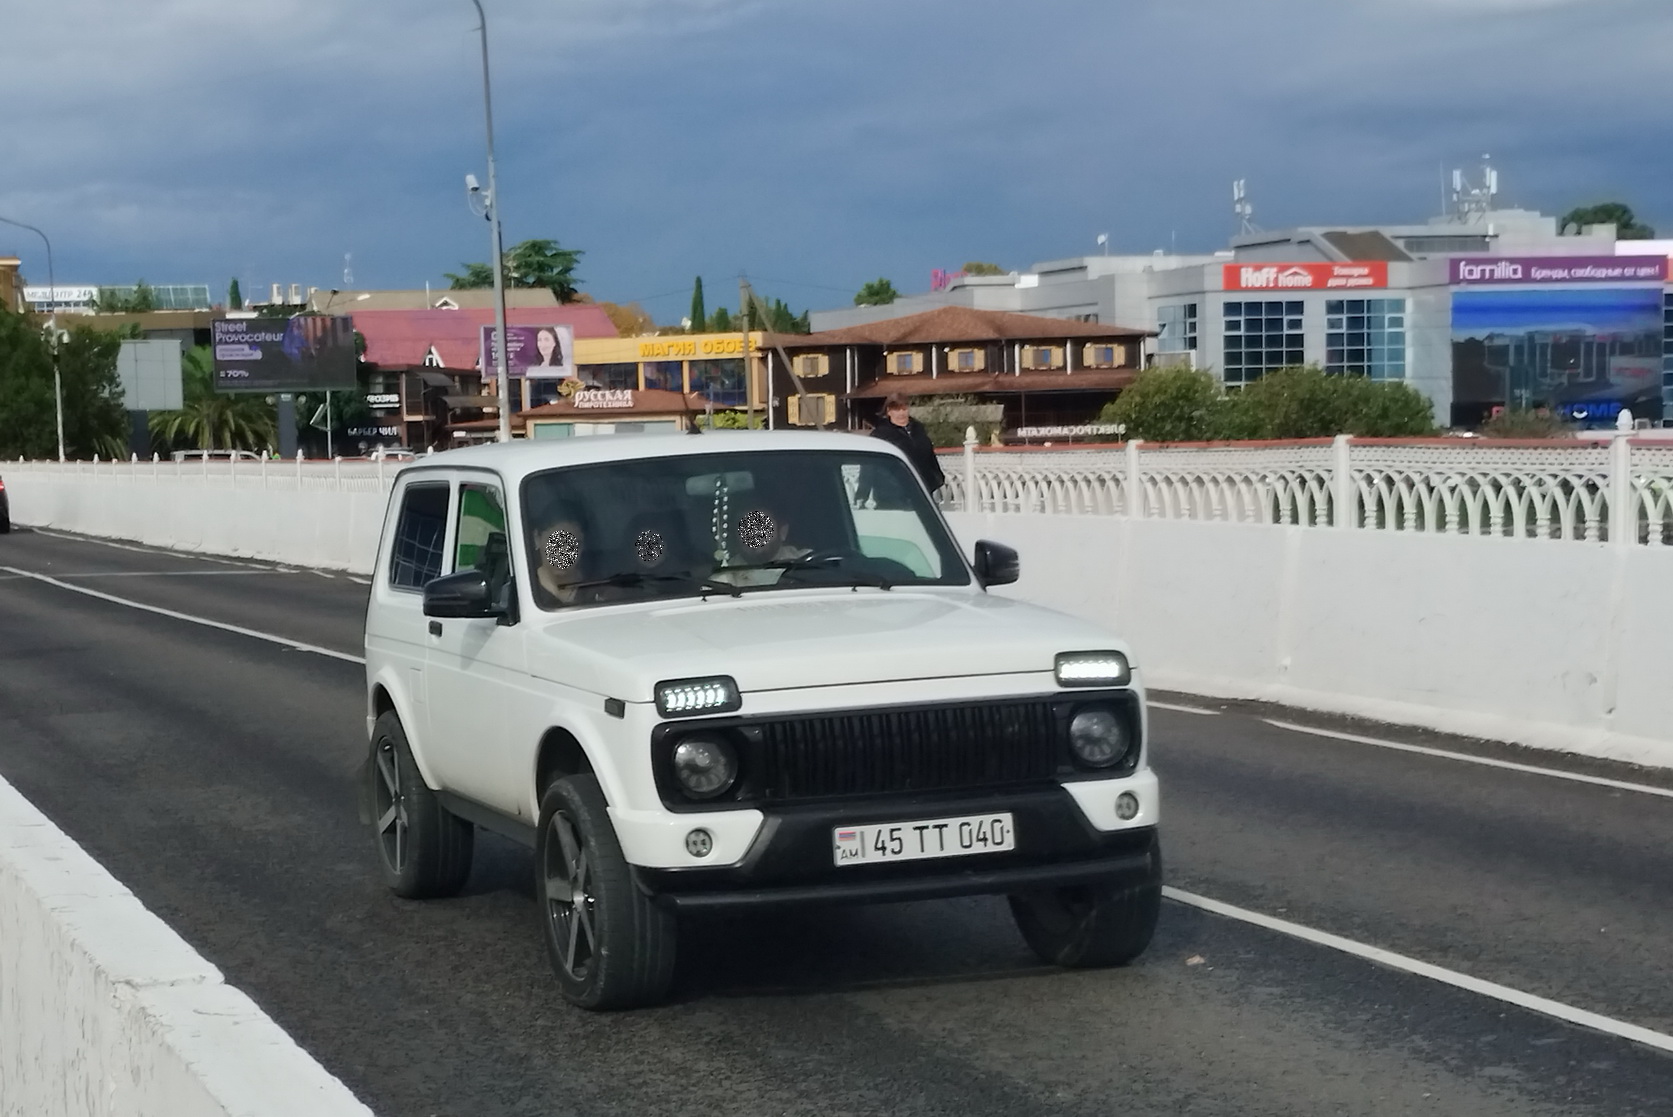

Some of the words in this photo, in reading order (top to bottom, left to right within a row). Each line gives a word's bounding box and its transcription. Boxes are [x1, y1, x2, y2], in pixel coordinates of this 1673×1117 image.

[1240, 267, 1278, 287] Hoff
[1278, 273, 1313, 287] home
[1459, 261, 1523, 280] familia
[214, 321, 247, 332] Street
[215, 332, 284, 343] Provocateur
[639, 341, 697, 357] МАГИЯ
[702, 336, 757, 355] ОБОЕВ
[574, 389, 633, 408] РУССКАЯ
[874, 828, 904, 857] 45
[912, 823, 949, 853] TT
[958, 818, 1005, 849] 040
[840, 848, 860, 861] AM
